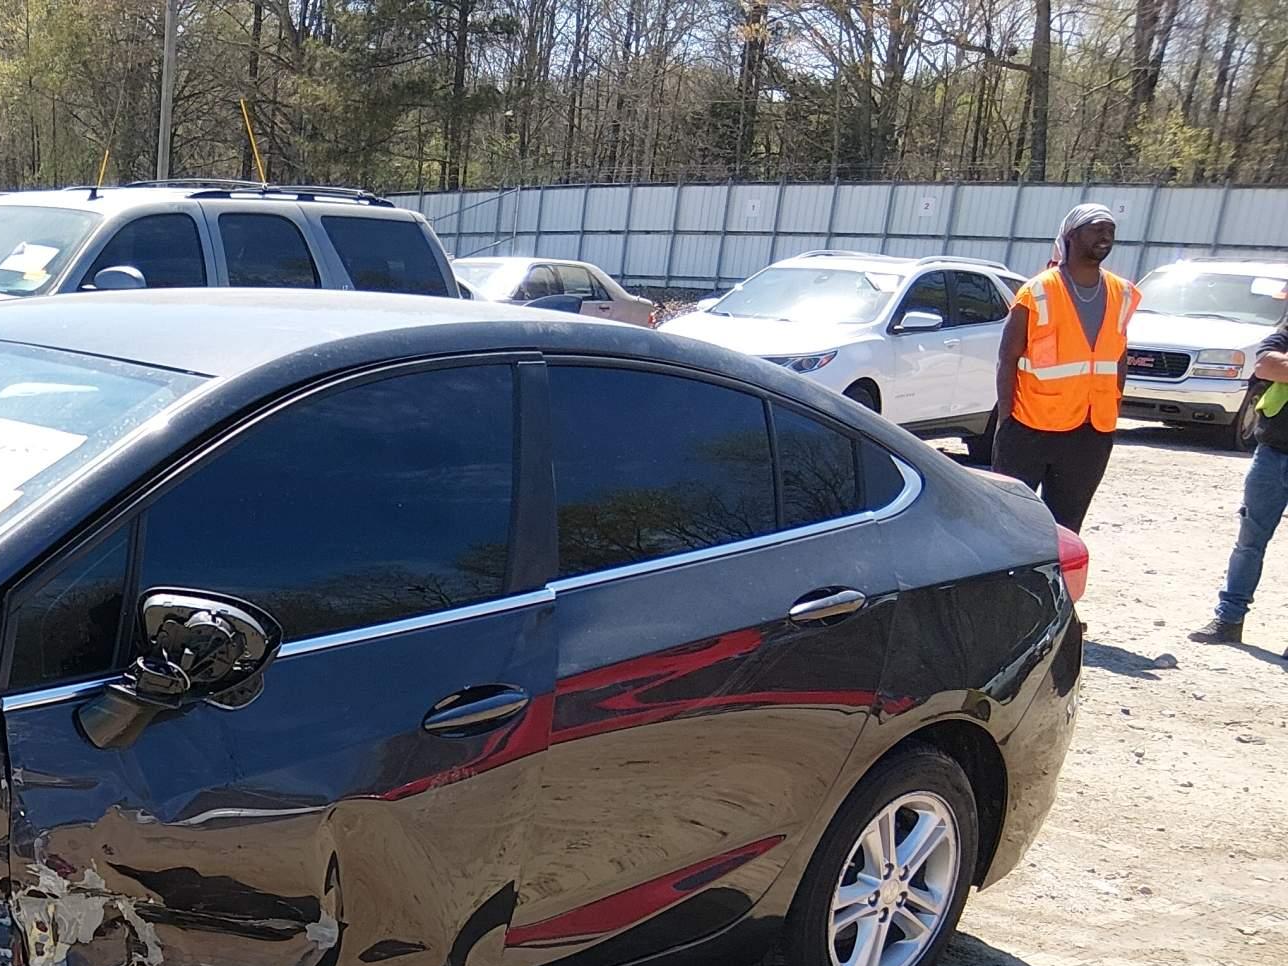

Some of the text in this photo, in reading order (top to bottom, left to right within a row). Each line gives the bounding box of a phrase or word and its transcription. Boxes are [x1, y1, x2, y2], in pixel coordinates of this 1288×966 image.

[924, 202, 930, 210] 2
[1119, 205, 1125, 213] 3
[1126, 356, 1155, 367] MC
